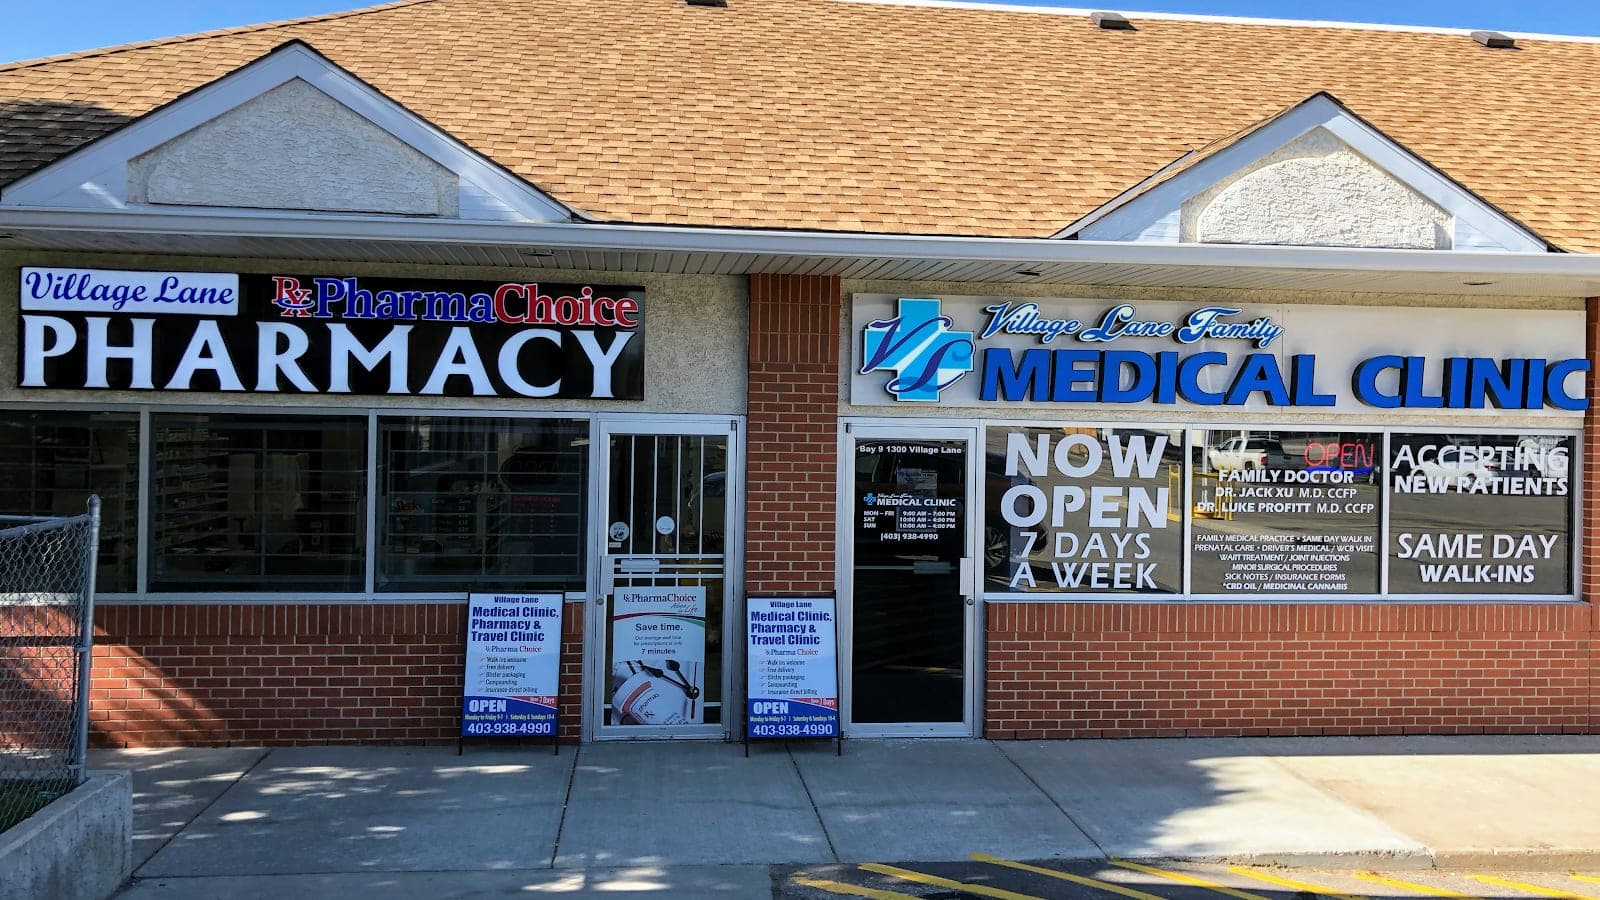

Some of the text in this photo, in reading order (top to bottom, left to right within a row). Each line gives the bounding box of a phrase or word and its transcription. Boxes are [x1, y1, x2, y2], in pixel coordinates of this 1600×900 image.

[25, 272, 234, 310] Village Lane
[982, 301, 1285, 348] Village Lane Family
[20, 315, 636, 398] PHARMACY
[979, 348, 1590, 411] MEDICAL CLINIC
[859, 445, 876, 454] Bay
[909, 446, 939, 455] Village
[1004, 433, 1168, 479] NOW
[1304, 442, 1374, 468] OPEN
[1391, 444, 1569, 472] ACCEPTING
[1218, 469, 1354, 483] FAMILY DOCTOR
[1394, 475, 1569, 496] NEW PATIENTS
[1215, 487, 1357, 499] DR. JACK XU M.D. CCFP
[924, 499, 956, 507] CLINIC
[1000, 485, 1169, 528] OPEN
[1197, 502, 1375, 514] DR. LUKE PROFITT M.D. CCFP
[881, 533, 901, 541] (403)
[1196, 534, 1224, 542] FAMILY
[1224, 534, 1258, 542] MEDICAL
[1324, 535, 1341, 543] DAY
[1341, 535, 1363, 543] WALK
[1363, 535, 1372, 543] IN
[1019, 532, 1151, 559] 7 DAYS
[1261, 544, 1296, 552] DRIVER'S
[1296, 544, 1330, 552] MEDICAL
[1397, 533, 1560, 560] SAME DAY
[1242, 554, 1285, 562] TREATMENT
[1288, 554, 1310, 562] JOINT
[1310, 554, 1350, 562] INJECTIONS
[1232, 563, 1337, 571] MINOR SURGICAL PROCEDURES
[1009, 562, 1158, 589] A WEEK
[1225, 572, 1346, 581] SICK NOTES INSURANCE FORMS
[1419, 564, 1535, 584] WALK-INS
[494, 596, 520, 604] Village
[472, 606, 559, 618] Medical Clinic,
[751, 611, 832, 622] Medical Clinic,
[471, 618, 542, 630] Pharmacy &
[635, 623, 683, 631] Save time.
[750, 623, 816, 634] Pharmacy &
[471, 631, 545, 642] Travel Clinic
[750, 634, 820, 645] Travel Clinic
[469, 700, 507, 712] OPEN
[753, 702, 789, 714] OPEN
[467, 722, 551, 734] 403-938-4990
[753, 724, 833, 736] 403-938-4990
